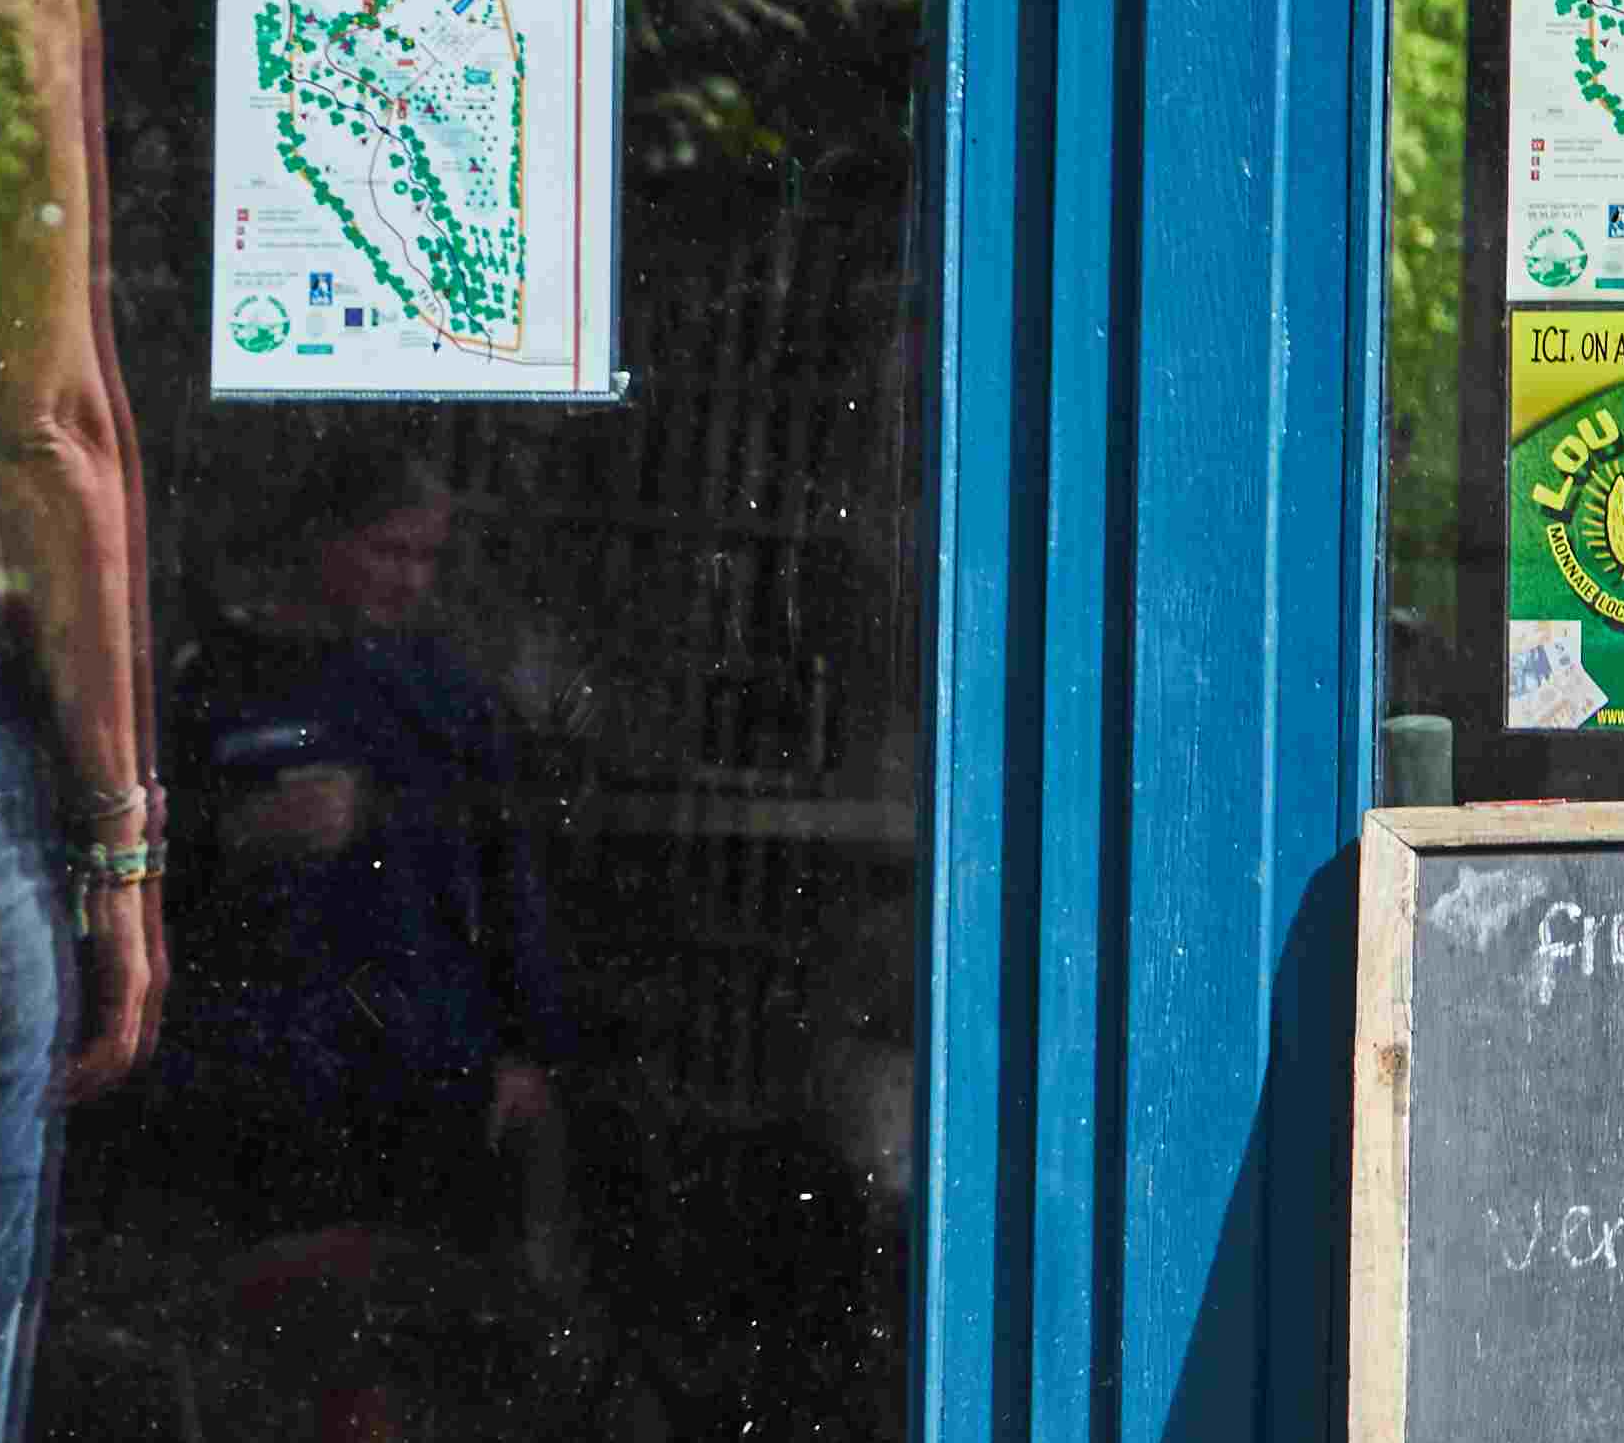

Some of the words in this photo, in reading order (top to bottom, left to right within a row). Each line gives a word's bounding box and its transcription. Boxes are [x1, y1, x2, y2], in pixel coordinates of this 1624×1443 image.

[1582, 330, 1610, 363] ON
[1531, 407, 1620, 512] LOU
[1549, 523, 1597, 601] MONNAIE
